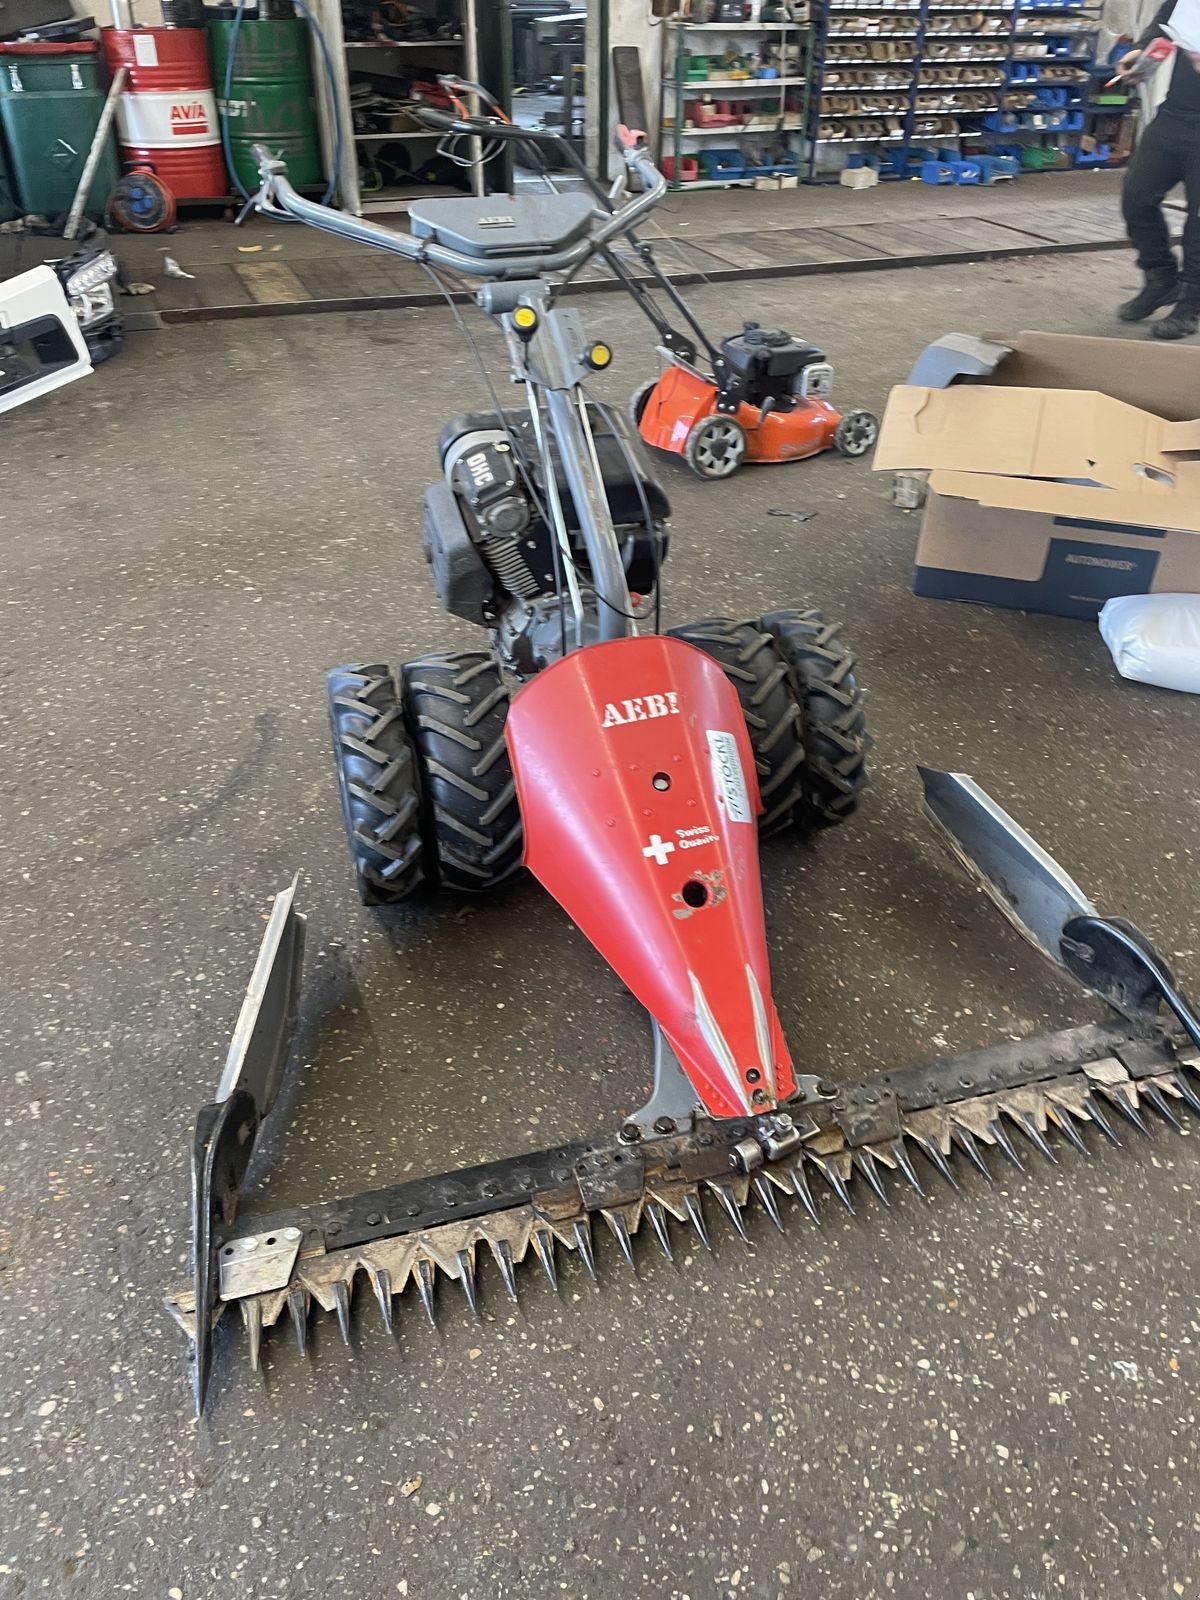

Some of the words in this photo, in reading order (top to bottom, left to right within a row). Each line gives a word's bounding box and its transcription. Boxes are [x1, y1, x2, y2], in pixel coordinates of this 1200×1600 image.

[170, 102, 207, 120] AVIA
[466, 453, 494, 486] OHC
[601, 692, 681, 728] AEBI
[675, 826, 711, 839] Swiss
